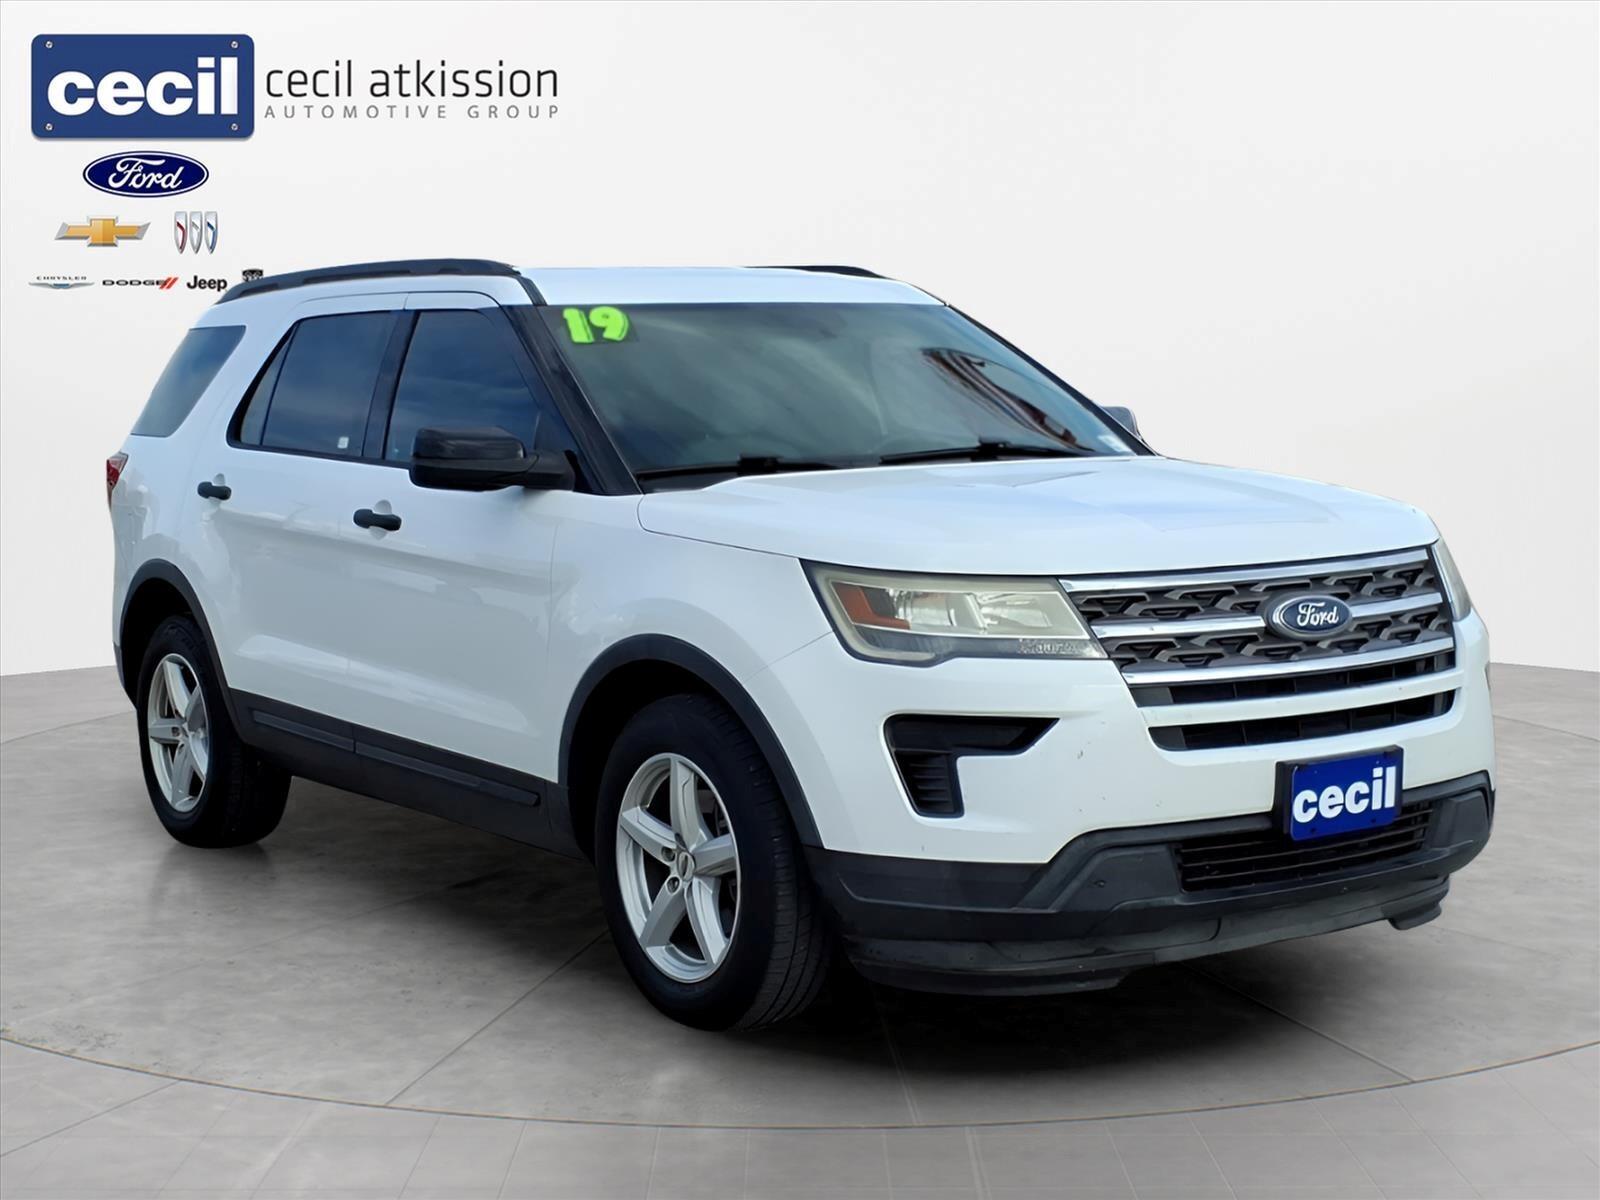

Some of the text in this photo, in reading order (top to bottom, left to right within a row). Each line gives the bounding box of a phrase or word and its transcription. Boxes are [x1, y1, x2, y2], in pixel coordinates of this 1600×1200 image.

[563, 306, 629, 344] 19
[1296, 602, 1340, 627] Ford
[1292, 766, 1397, 824] cecil
